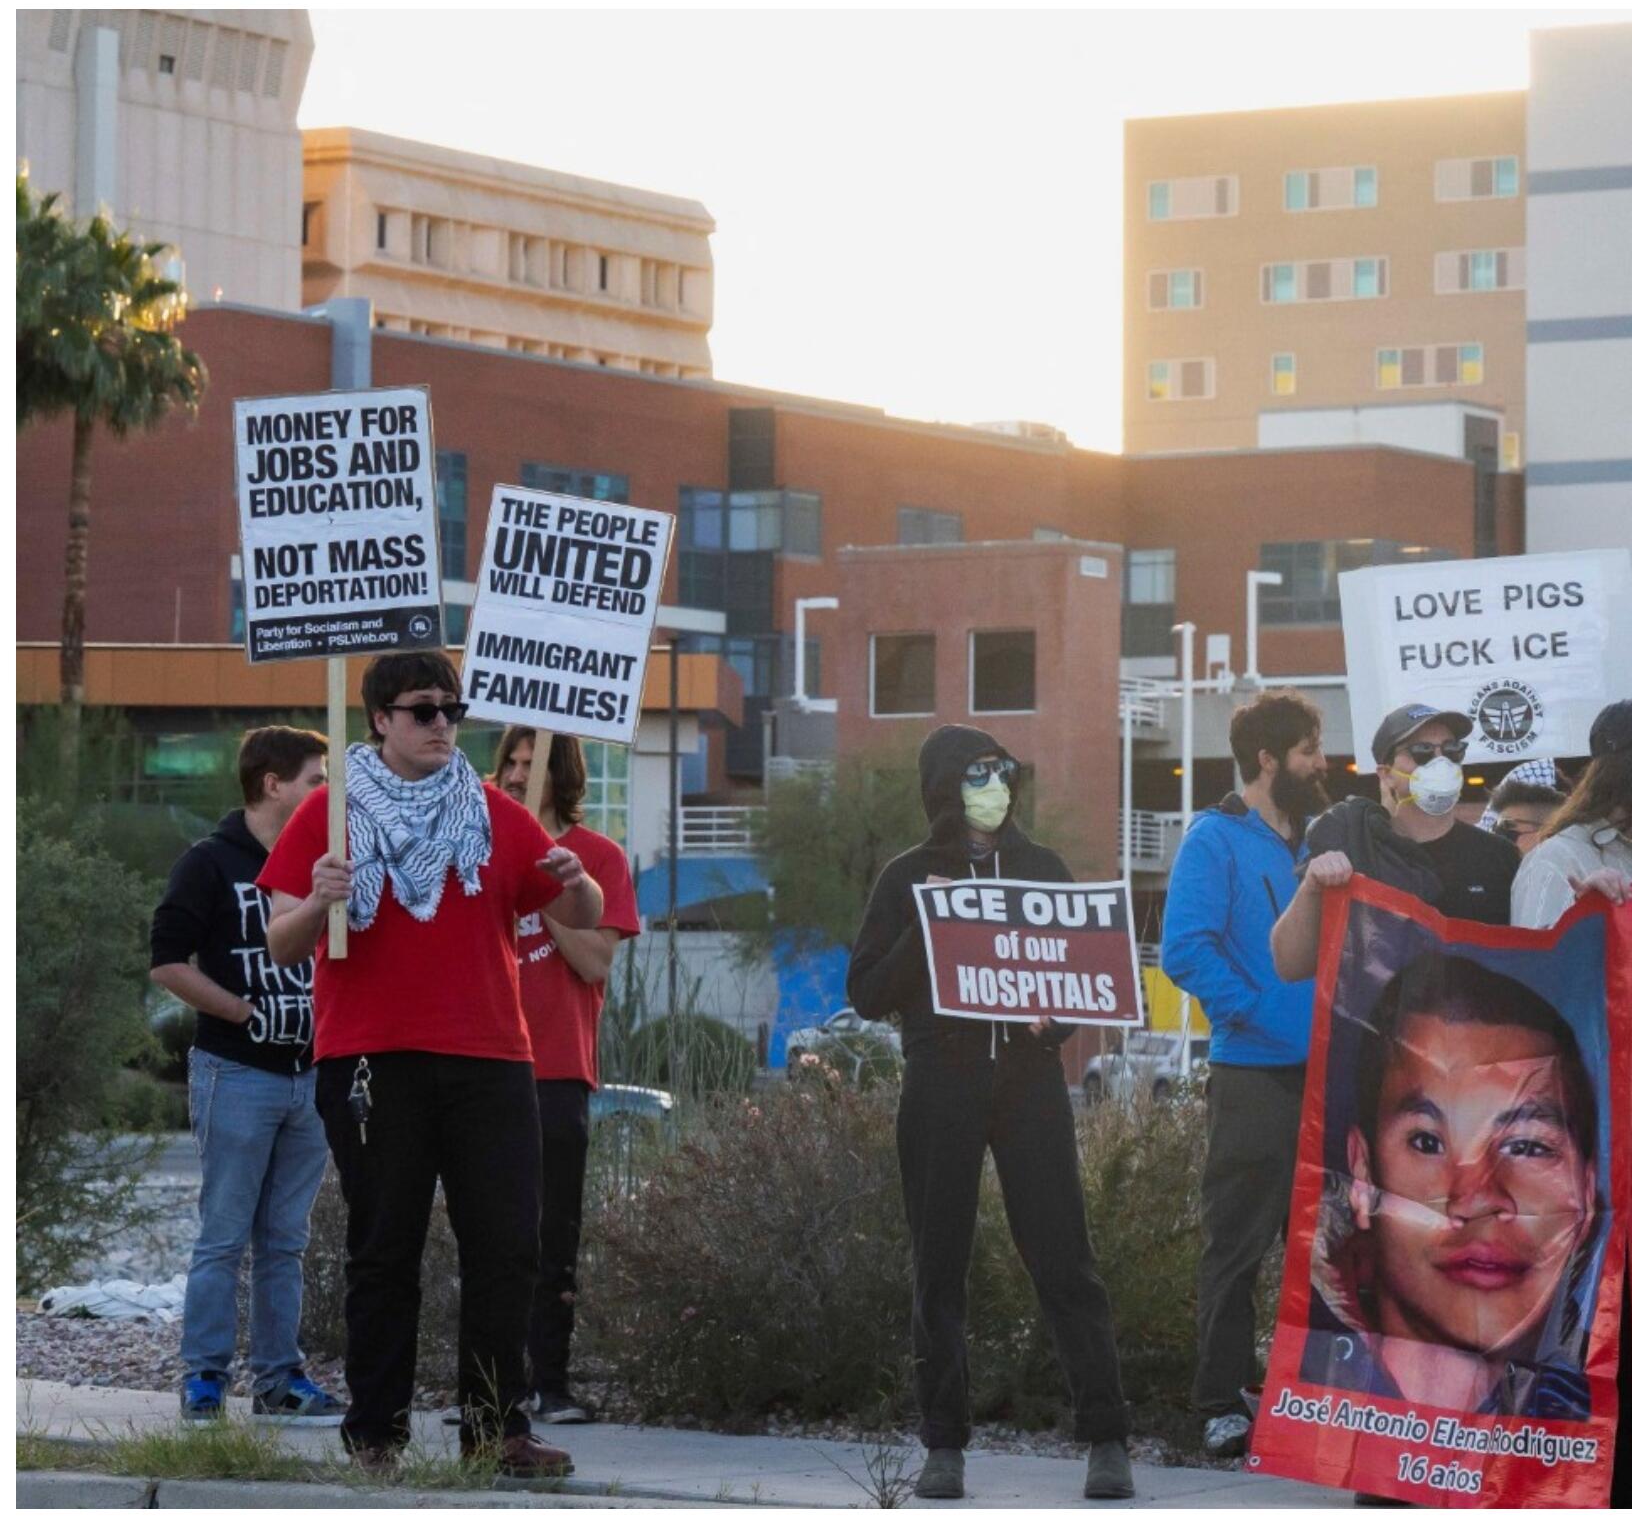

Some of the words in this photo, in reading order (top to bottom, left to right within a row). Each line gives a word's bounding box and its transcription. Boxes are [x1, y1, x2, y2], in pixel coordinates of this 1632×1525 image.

[247, 410, 351, 445] MONEY
[361, 405, 418, 437] FOR
[247, 445, 338, 484] JOBS
[348, 439, 420, 477] AND
[249, 478, 422, 518] EDUCATION,
[501, 498, 551, 529] THE
[557, 507, 659, 546] PEOPLE
[254, 544, 318, 579] NOT
[328, 534, 426, 573] MASS
[493, 527, 652, 590] UNITED
[255, 572, 428, 609] DEPORTATION!
[490, 570, 544, 600] WILL
[552, 579, 646, 615] DEFEND
[1395, 589, 1482, 621] LOVE
[1503, 582, 1584, 610] PIGS
[256, 627, 283, 640] Party
[287, 625, 301, 635] for
[305, 621, 359, 635] Socialism
[361, 618, 383, 629] and
[257, 640, 311, 652] Liberation
[328, 632, 398, 646] PSLWeb.org
[476, 631, 637, 680] IMMIGRANT
[1400, 638, 1494, 671] FUCK
[1514, 631, 1569, 661] ICE
[469, 669, 629, 724] FAMILIES!
[1479, 731, 1537, 753] FASCISM
[932, 888, 1007, 921] ICE
[1022, 892, 1117, 927] OUT
[995, 931, 1019, 960] of
[1025, 937, 1068, 962] our
[957, 964, 1117, 1012] HOSPITALS
[1273, 1389, 1329, 1422] José
[1333, 1400, 1427, 1441] Antonio
[1432, 1418, 1496, 1451] Elena
[1398, 1453, 1426, 1482] 16
[1430, 1462, 1481, 1493] años
